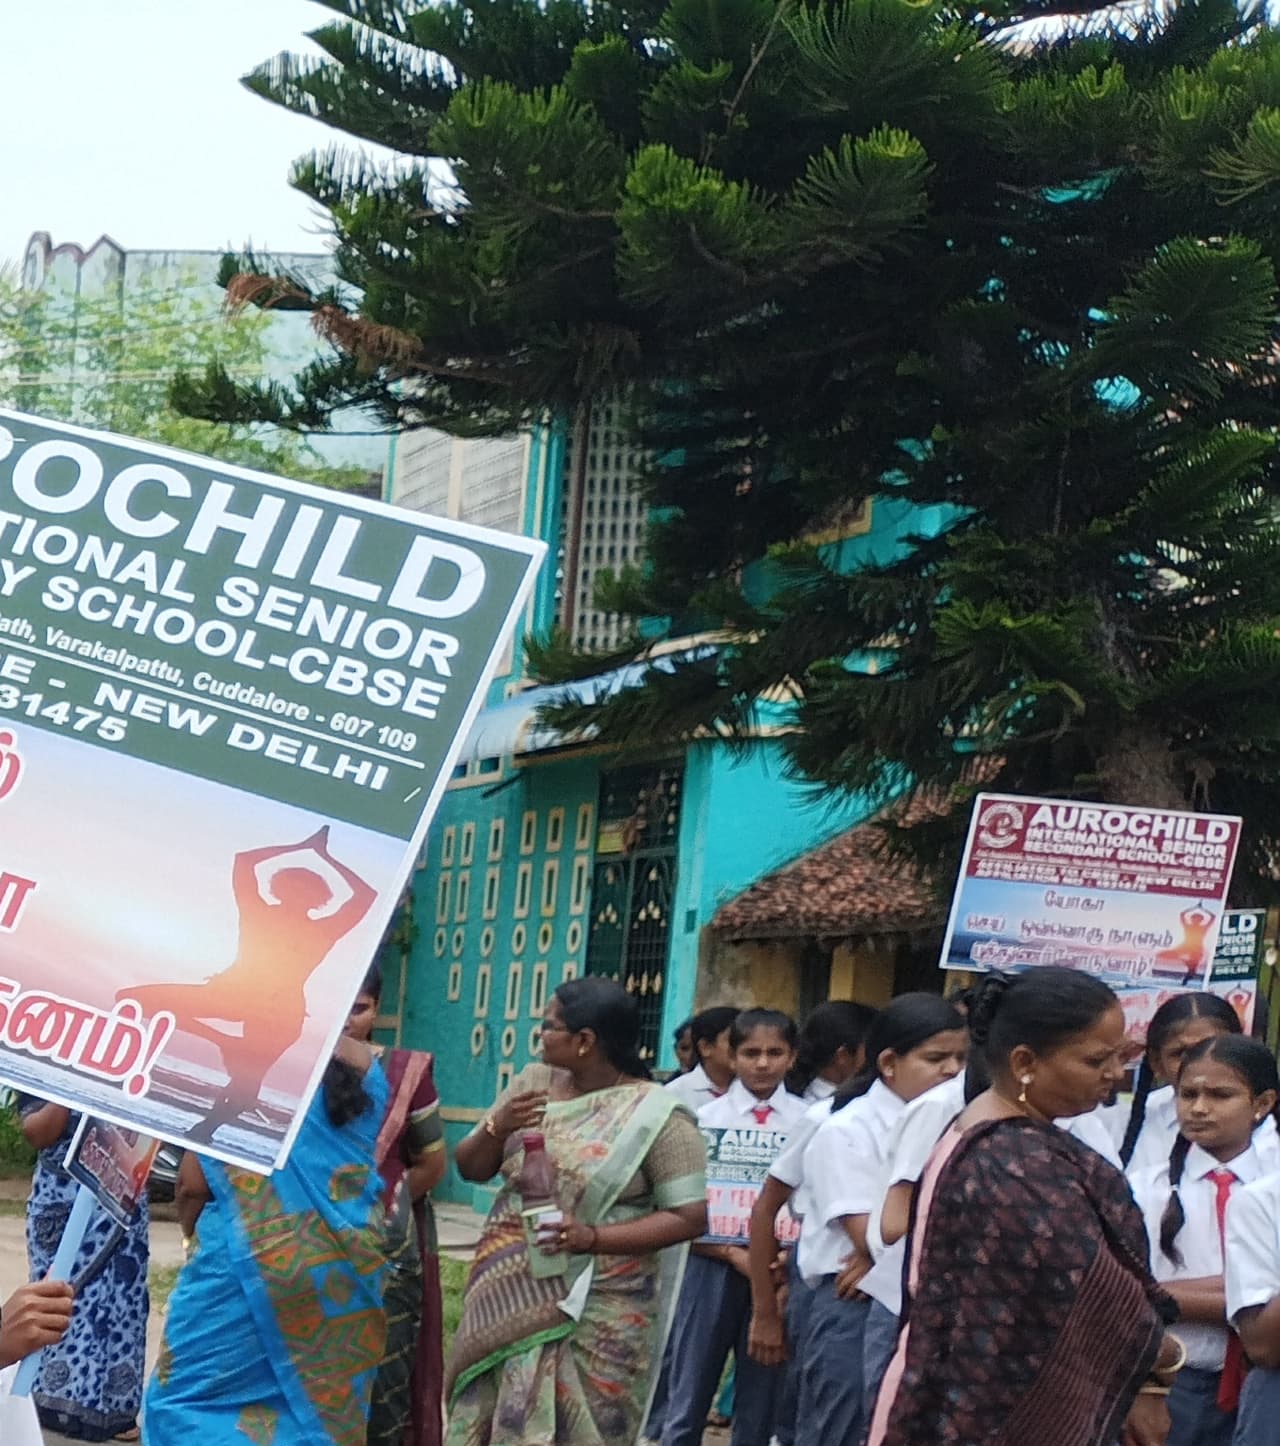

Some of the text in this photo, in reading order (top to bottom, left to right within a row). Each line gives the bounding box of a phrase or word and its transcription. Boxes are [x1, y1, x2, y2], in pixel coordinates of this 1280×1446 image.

[42, 576, 448, 721] SCHOOL-CBSE
[215, 576, 461, 676] SENIOR
[45, 627, 185, 686] Varakalpattu,
[193, 672, 309, 721] Cuddalore
[330, 712, 374, 737] 607
[377, 725, 417, 752] 109
[93, 682, 218, 737] NEW
[227, 723, 389, 791] DELHI
[1024, 841, 1113, 859] SECONDARY
[1117, 849, 1225, 870] SCHOOL-CBSE
[1027, 829, 1227, 858] INTERNATIONAL SENIOR
[1029, 805, 1231, 843] AUROCHILD
